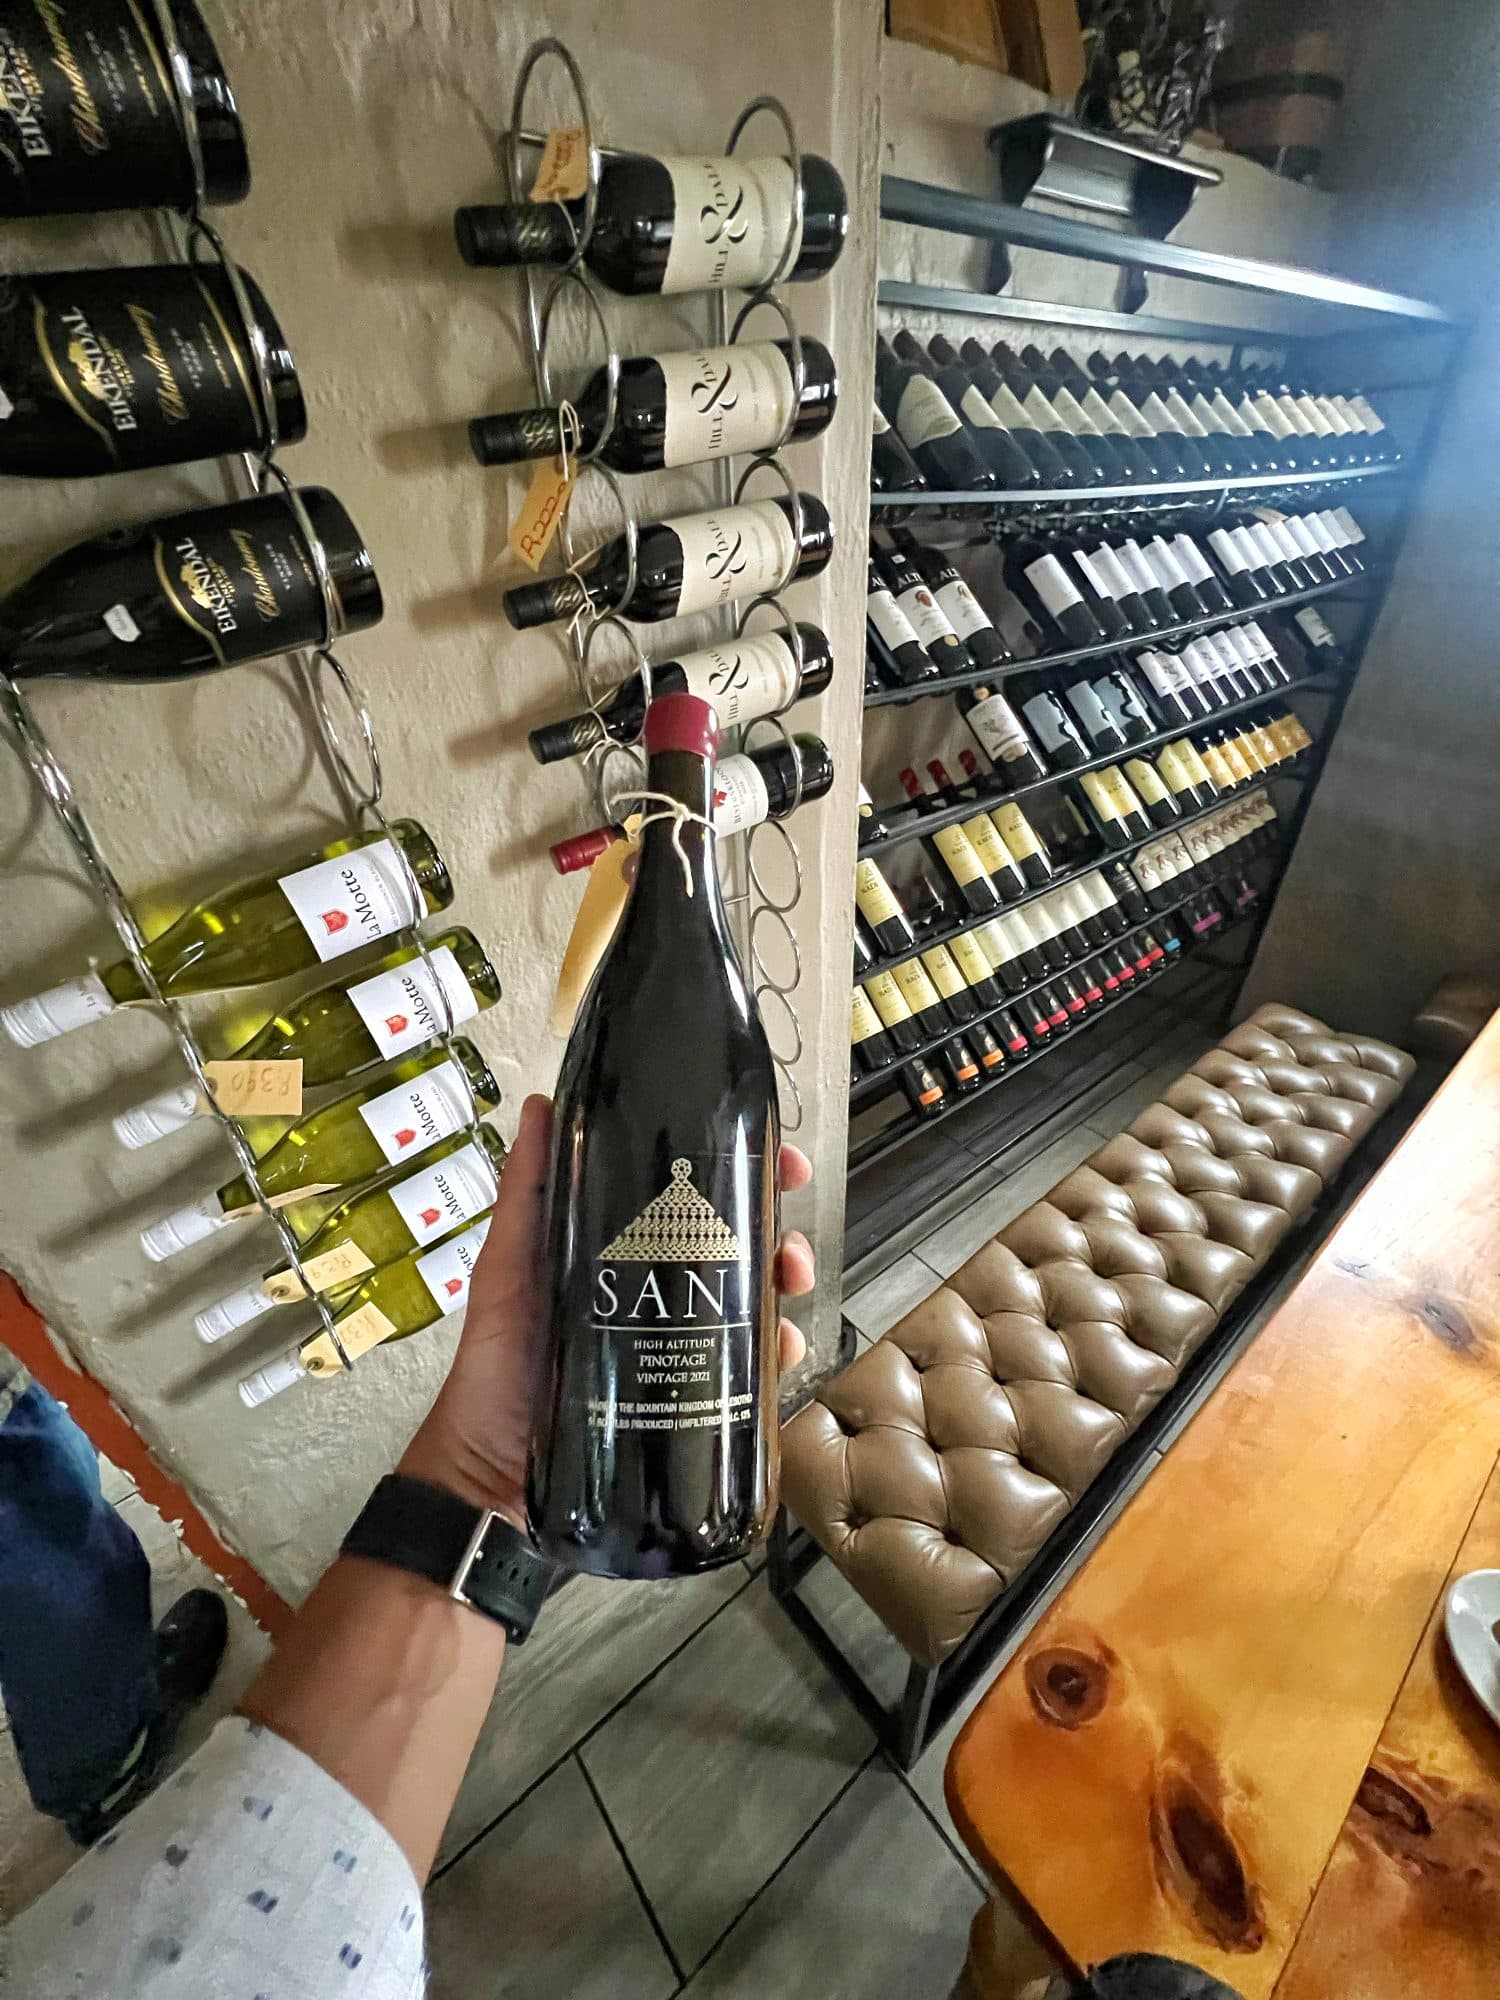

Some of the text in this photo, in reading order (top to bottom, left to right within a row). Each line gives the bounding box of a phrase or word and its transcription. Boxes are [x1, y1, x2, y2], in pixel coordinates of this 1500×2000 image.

[698, 183, 750, 246] &
[60, 304, 138, 422] EIKENDAL
[124, 302, 190, 425] Chardonnay
[690, 361, 740, 416] &
[228, 528, 282, 623] Chardonnay
[704, 530, 748, 580] &
[175, 536, 239, 634] EIKENDAL
[708, 653, 750, 696] &
[340, 868, 383, 940] La Motte
[401, 976, 433, 1025] Motte
[409, 1093, 439, 1137] Motte
[434, 1173, 463, 1216] Motte
[456, 1245, 475, 1278] otte
[593, 1268, 751, 1318] SANI
[633, 1337, 716, 1350] HIGH ALTITUDE
[639, 1353, 707, 1367] PINOTAGE
[636, 1371, 710, 1384] VINTAGE 2021
[636, 1402, 678, 1413] MOUNTAIN
[679, 1399, 715, 1413] KINGDOM
